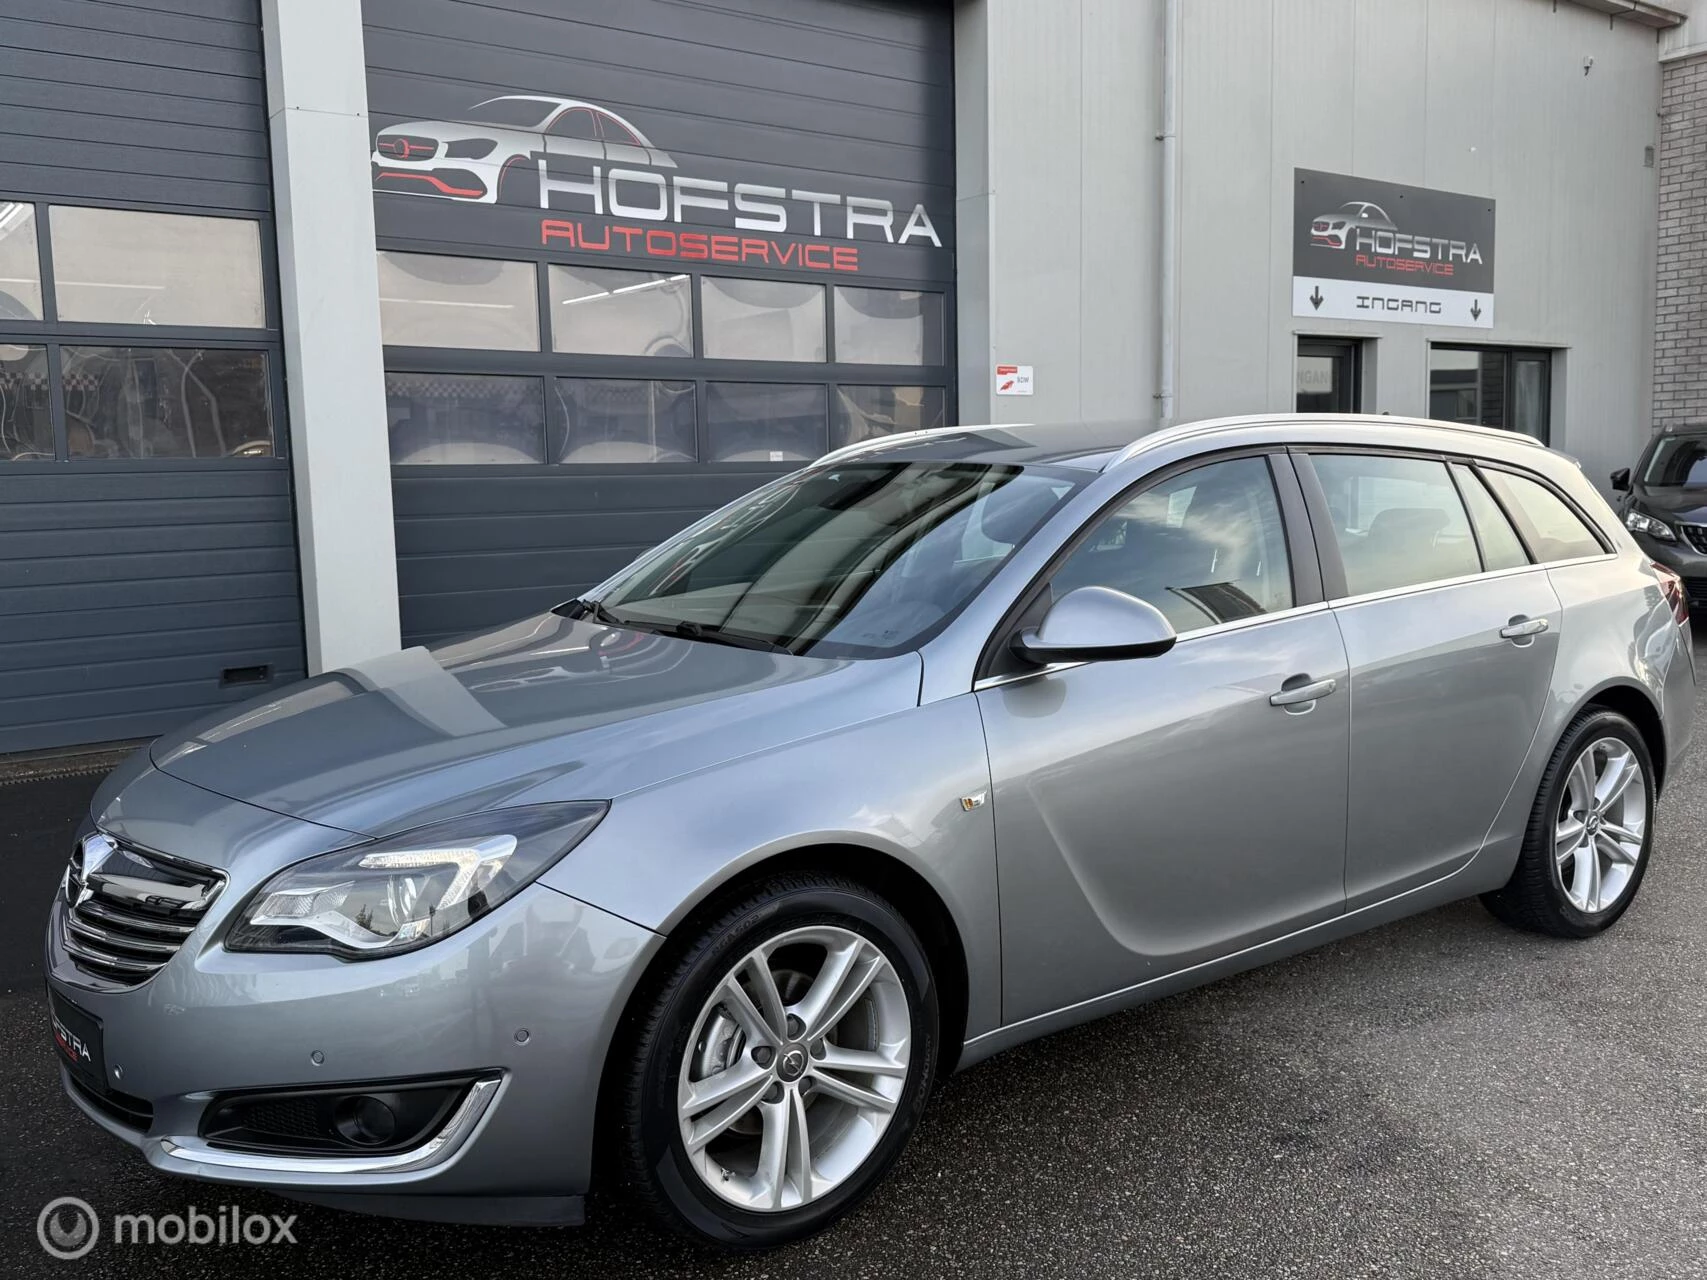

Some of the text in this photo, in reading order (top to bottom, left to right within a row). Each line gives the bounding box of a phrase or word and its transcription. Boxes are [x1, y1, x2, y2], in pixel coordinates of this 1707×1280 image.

[536, 159, 943, 248] HOFSTRA
[541, 218, 859, 271] AUTOSERVICE
[1356, 228, 1483, 265] HOFSTRA
[1356, 254, 1454, 276] AUTOSERVICE
[1356, 295, 1442, 315] INGANG
